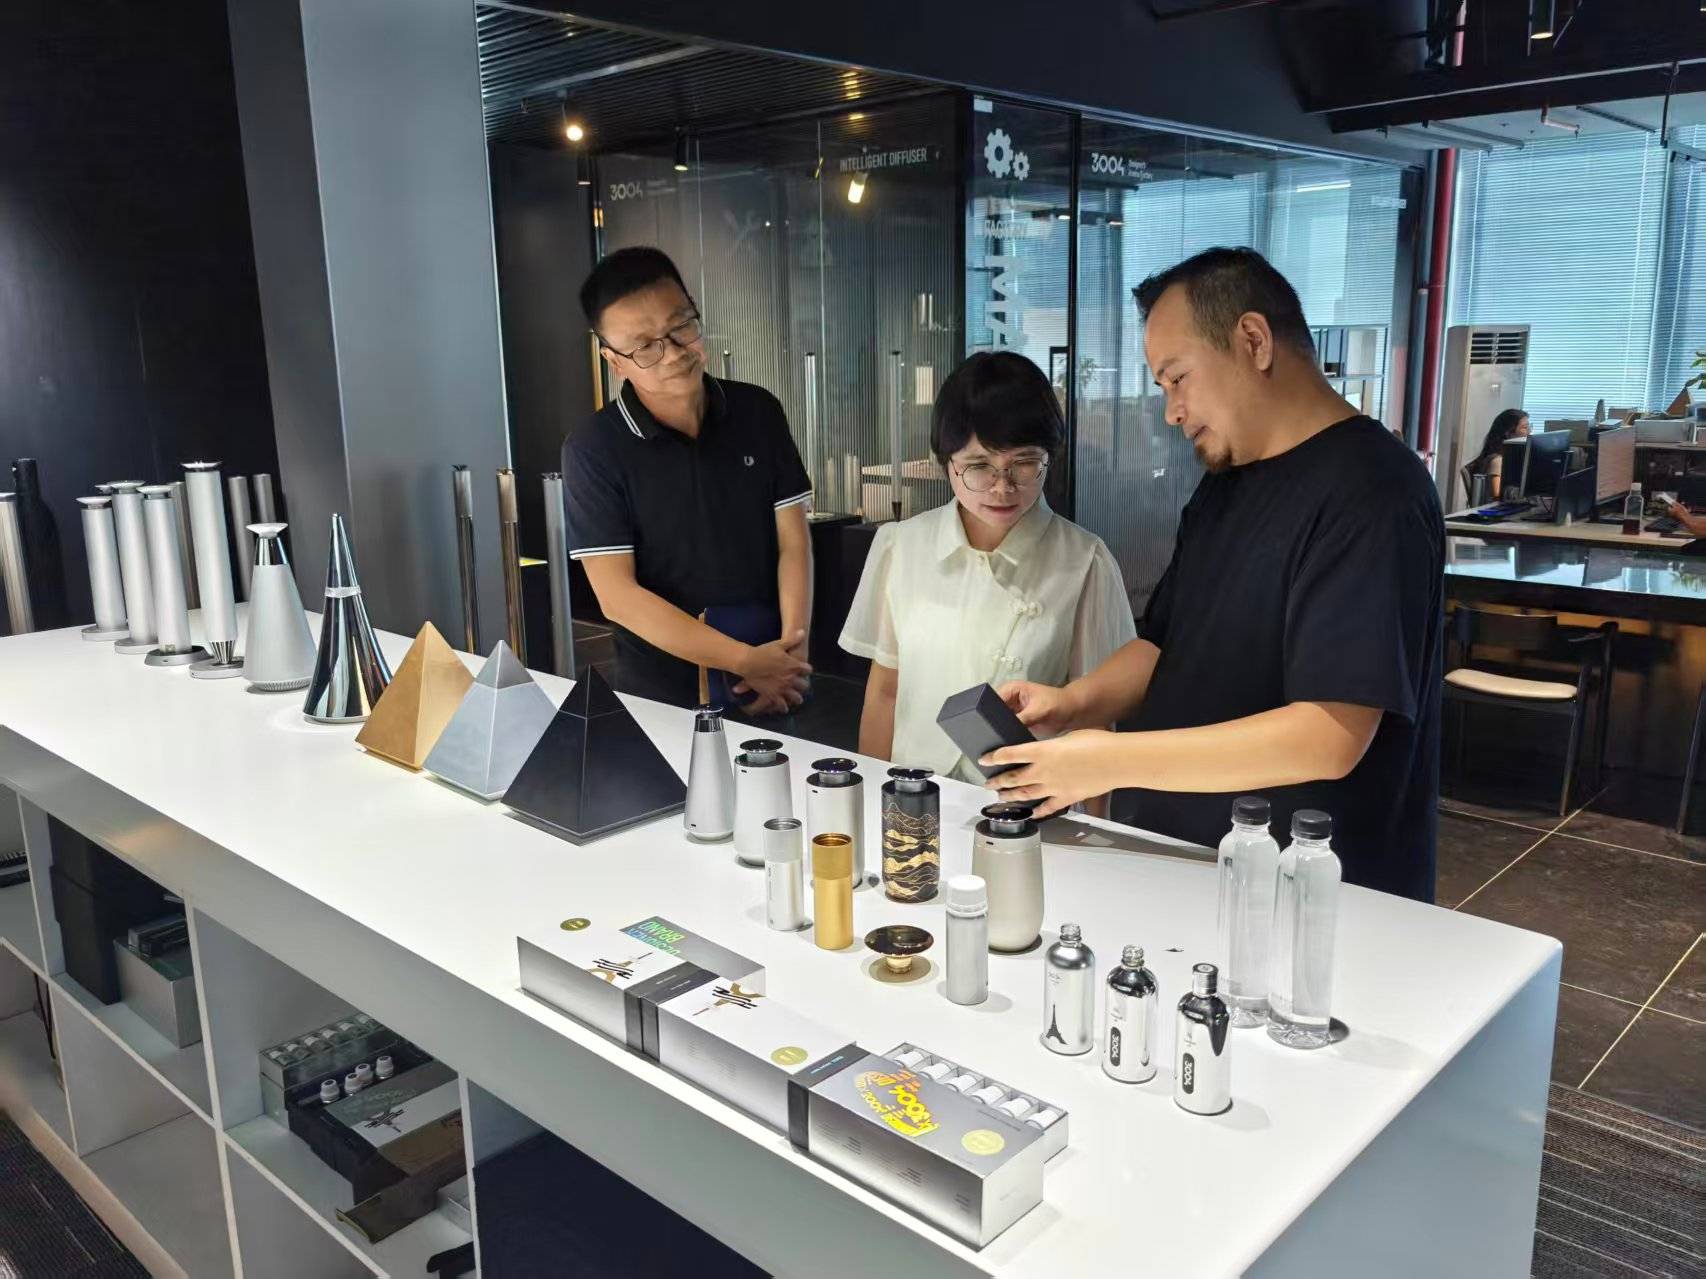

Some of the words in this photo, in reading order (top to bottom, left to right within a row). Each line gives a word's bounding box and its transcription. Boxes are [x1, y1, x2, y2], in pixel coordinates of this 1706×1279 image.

[840, 153, 888, 172] INTELLIGENT
[889, 148, 927, 166] DIFFUSER
[1092, 152, 1125, 177] 3004
[609, 182, 644, 201] 3004
[1111, 1034, 1120, 1058] 3004
[1184, 1061, 1193, 1086] 3004
